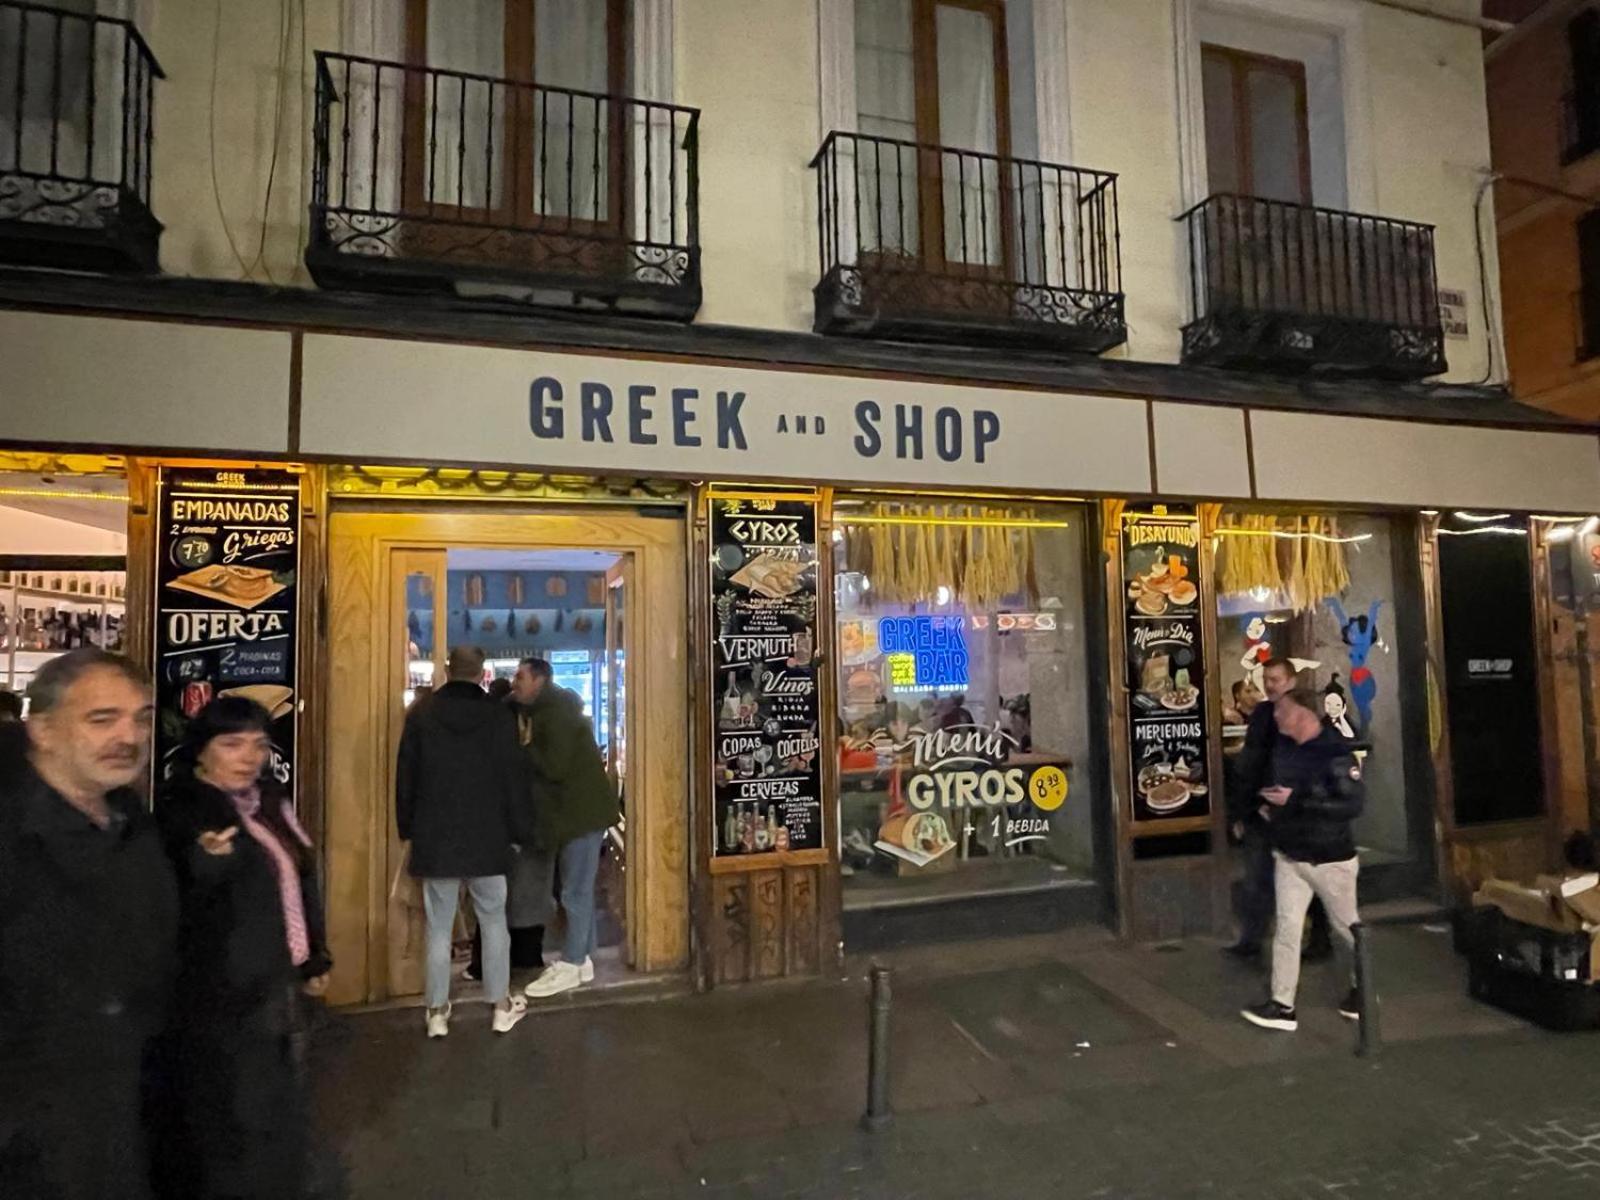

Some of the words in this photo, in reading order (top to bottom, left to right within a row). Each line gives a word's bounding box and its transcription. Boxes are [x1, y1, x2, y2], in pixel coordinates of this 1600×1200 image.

[528, 376, 748, 450] GREEK
[776, 414, 826, 436] AND
[853, 400, 1001, 464] SHOP
[172, 500, 290, 522] EMPANADAS
[729, 520, 801, 542] GYROS
[222, 529, 295, 564] Griegas
[168, 612, 283, 645] OFERTA
[879, 617, 966, 655] GREEK
[719, 638, 798, 663] VERMUTH
[917, 652, 970, 685] BAR
[762, 670, 814, 695] Vinos
[893, 720, 1006, 767] Menú
[1136, 722, 1202, 743] MERIENDAS
[722, 737, 762, 757] COPAS
[741, 781, 800, 800] CERVEZAS
[908, 768, 1025, 810] GYROS
[991, 815, 1001, 838] 1
[1006, 818, 1050, 835] BEBIDA
